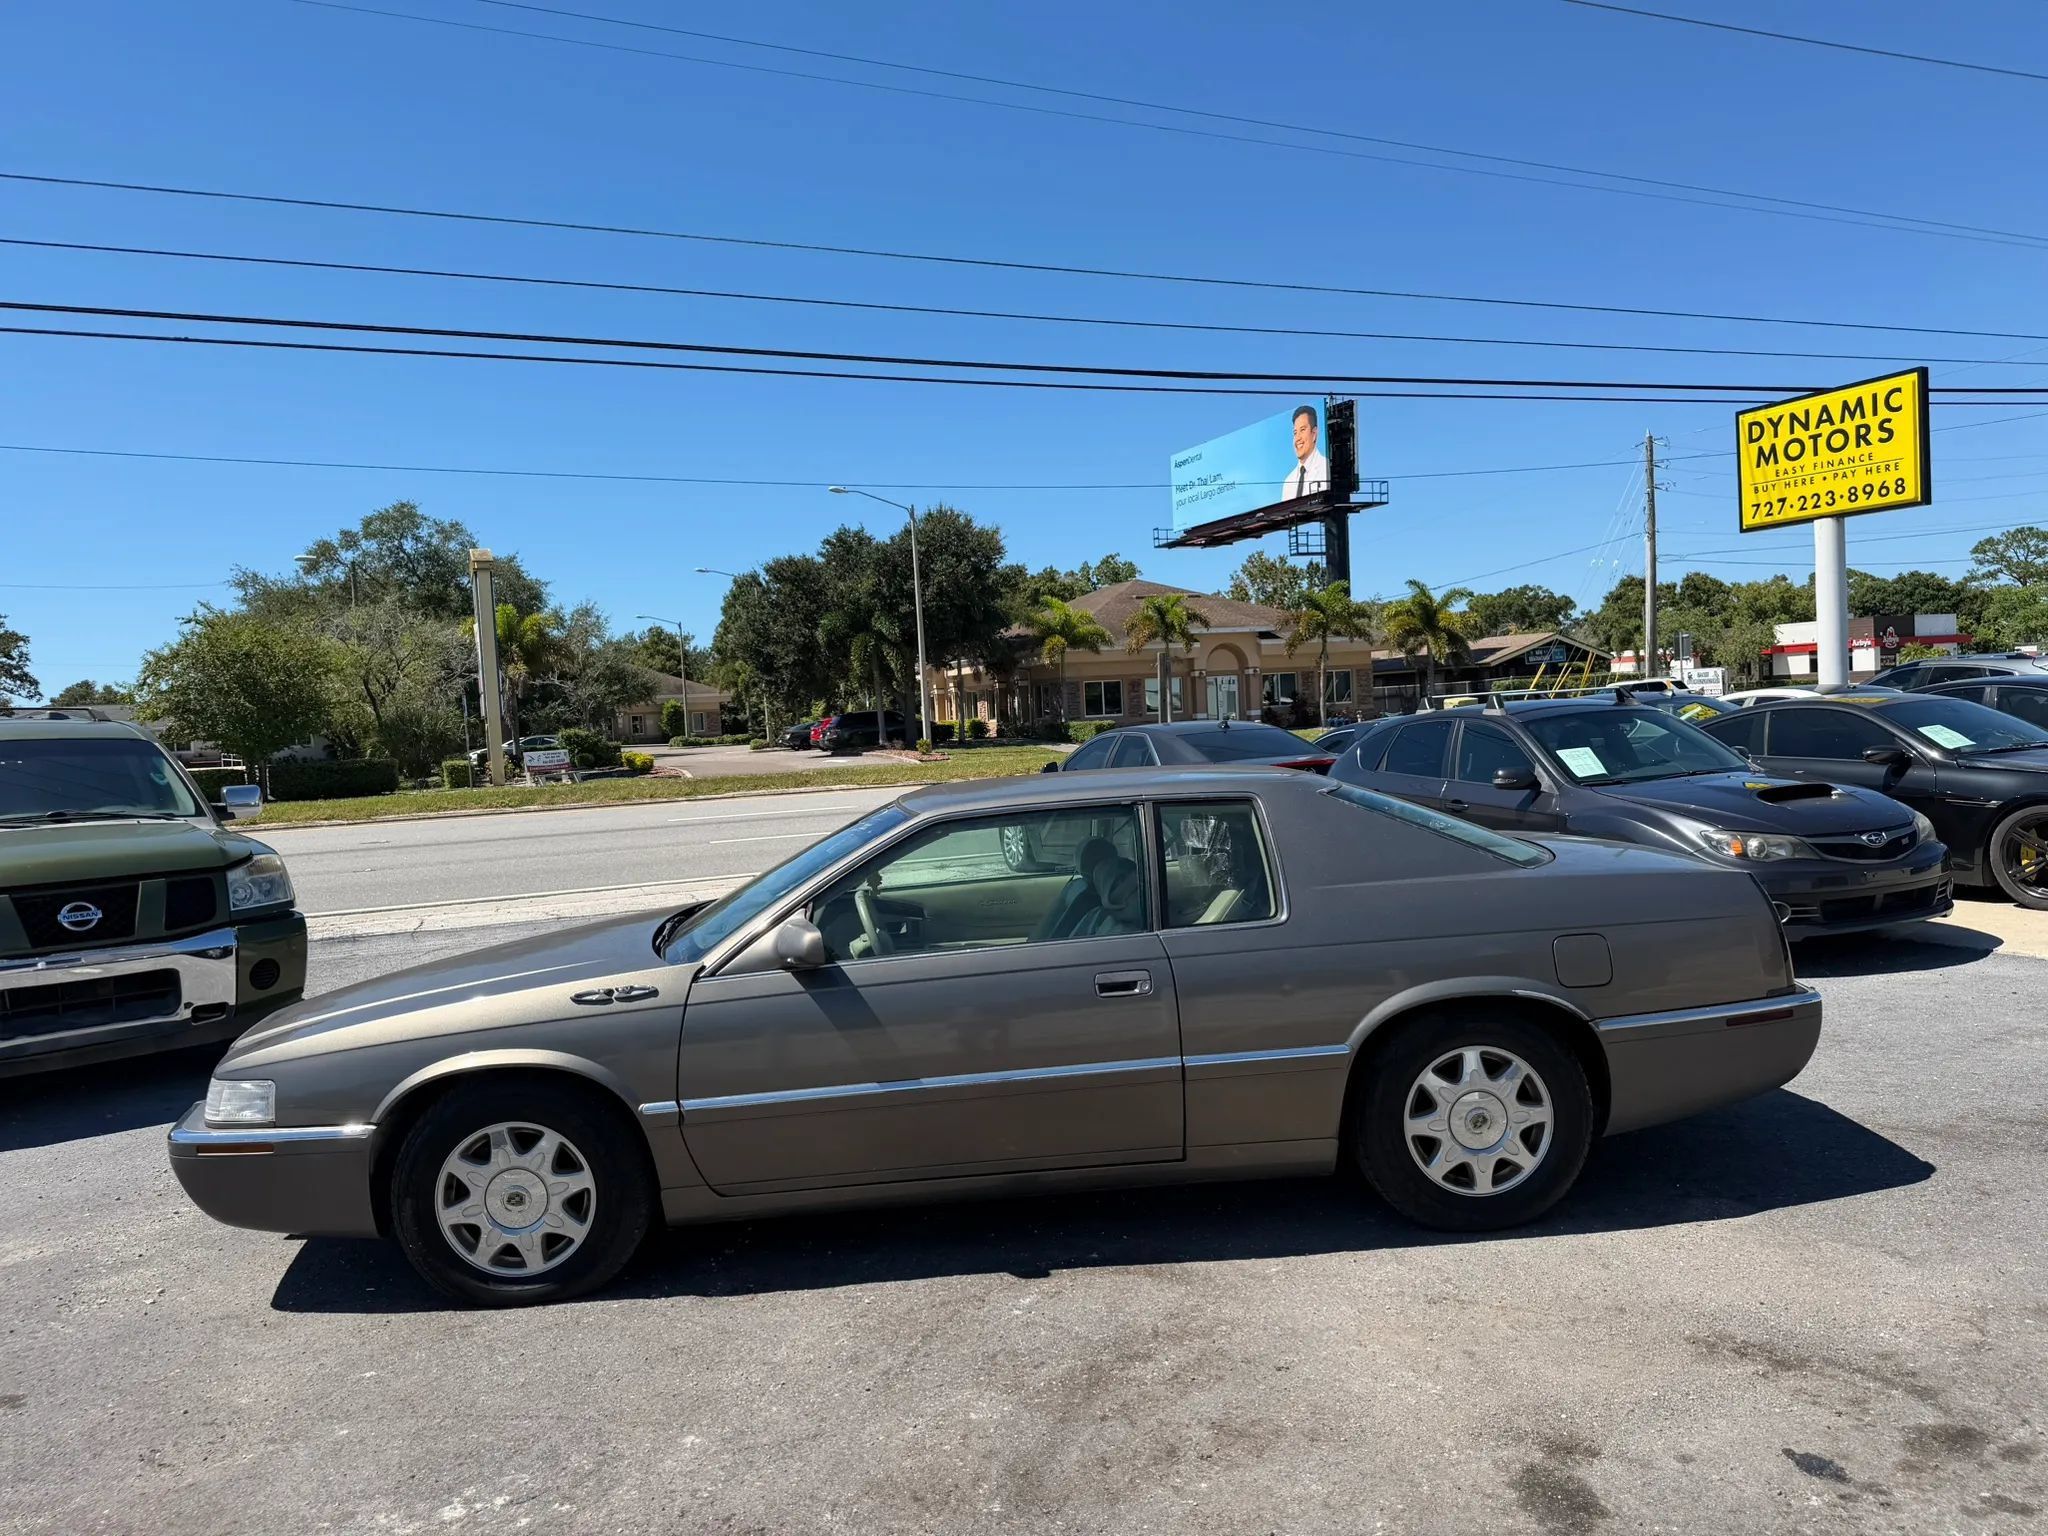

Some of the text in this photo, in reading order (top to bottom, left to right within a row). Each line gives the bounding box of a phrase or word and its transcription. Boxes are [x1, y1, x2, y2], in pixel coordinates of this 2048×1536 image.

[1747, 387, 1903, 445] DYNAMIC
[1755, 417, 1895, 469] MOTORS
[1775, 452, 1874, 478] EASY FINANCE
[1175, 483, 1189, 494] Meet
[1753, 462, 1900, 495] BUY HERE PAY HERE
[1851, 638, 1872, 647] Arby's
[62, 911, 98, 920] NISSAN
